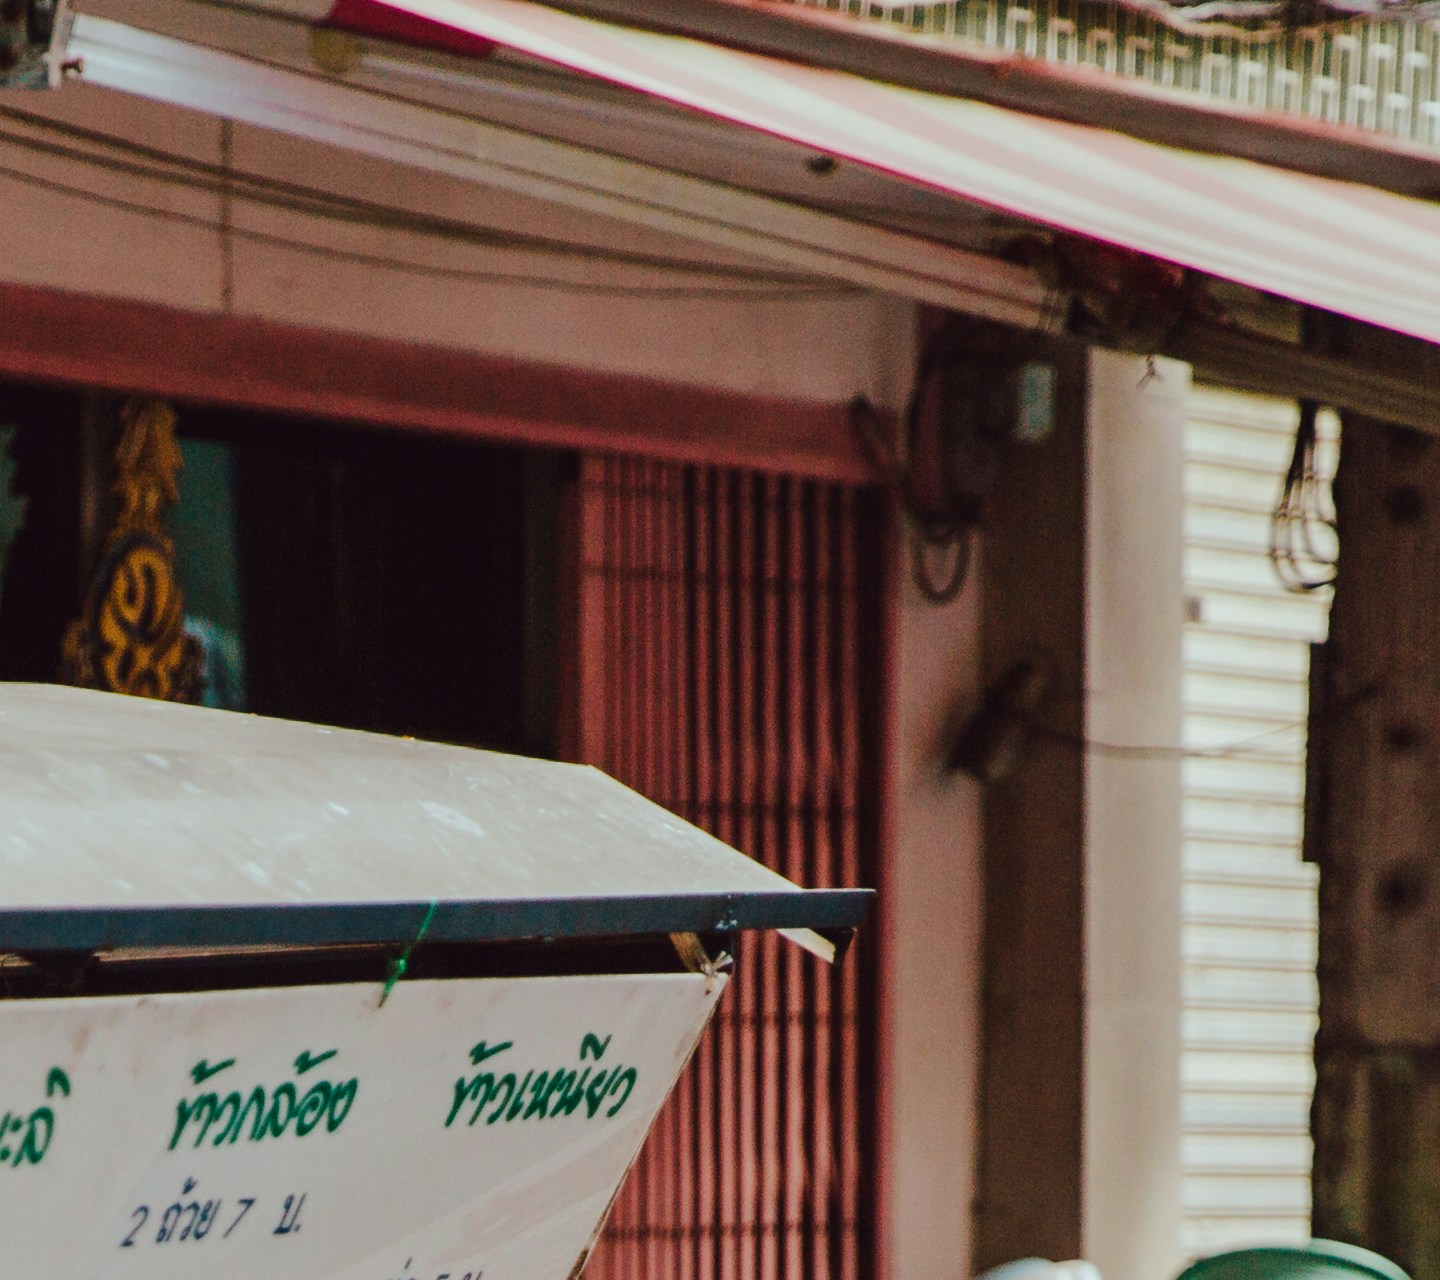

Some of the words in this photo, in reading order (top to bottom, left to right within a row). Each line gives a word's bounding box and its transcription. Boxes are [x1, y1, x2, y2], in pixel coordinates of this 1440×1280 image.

[167, 1049, 359, 1151] ข้าวกล้อง
[444, 1032, 638, 1128] ข้าวเหนียว
[120, 1205, 150, 1248] 2
[155, 1177, 221, 1244] ถ้วย
[225, 1198, 256, 1236] 7
[273, 1194, 305, 1236] บ.
